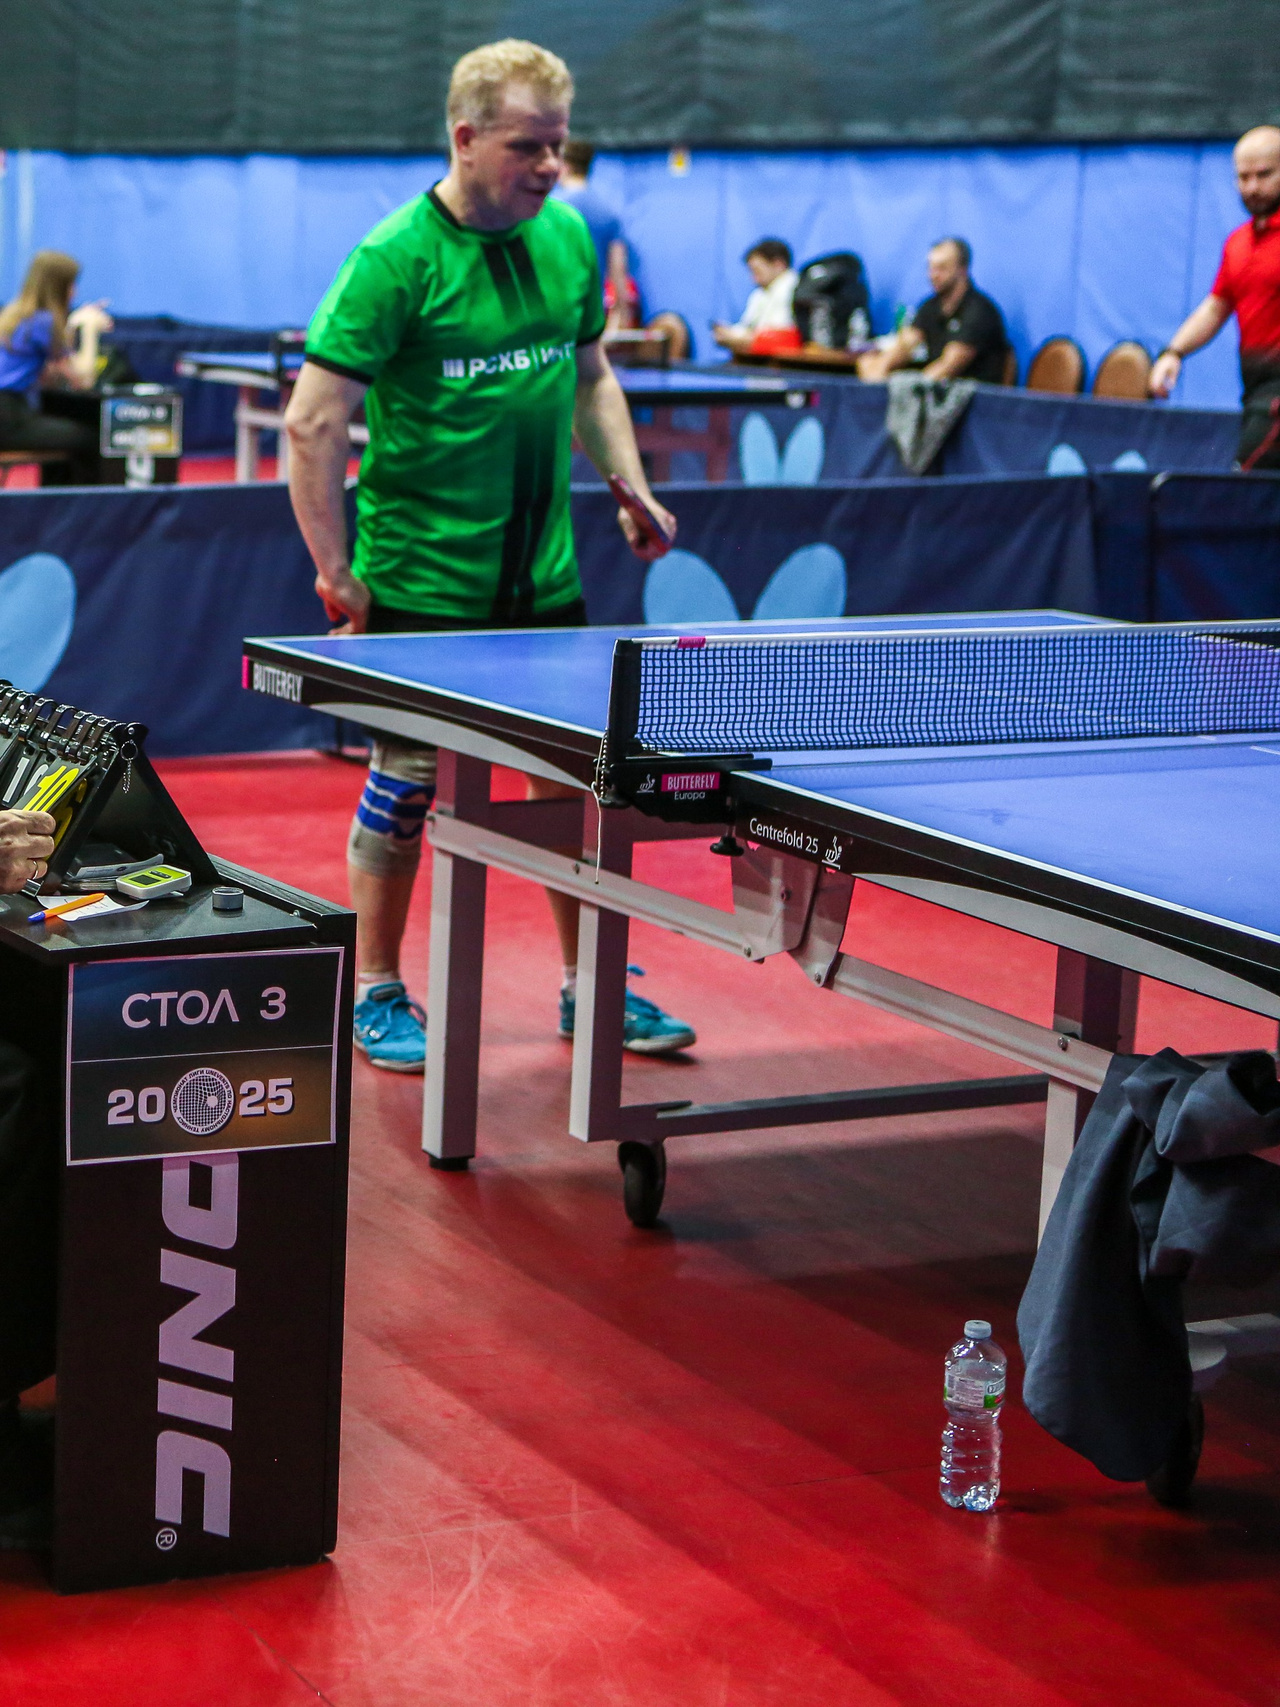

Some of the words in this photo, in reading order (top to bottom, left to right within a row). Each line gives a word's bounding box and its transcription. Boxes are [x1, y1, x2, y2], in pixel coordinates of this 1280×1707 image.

[253, 663, 303, 703] BUTTERFLY
[667, 774, 715, 791] BUTTERFLY
[674, 790, 706, 801] Europa
[749, 817, 804, 850] Centrefold
[805, 835, 819, 854] 25
[121, 988, 240, 1029] СТОЛ
[259, 986, 287, 1020] 3
[107, 1086, 167, 1126] 20
[238, 1077, 294, 1116] 25
[155, 1152, 239, 1538] ONIC
